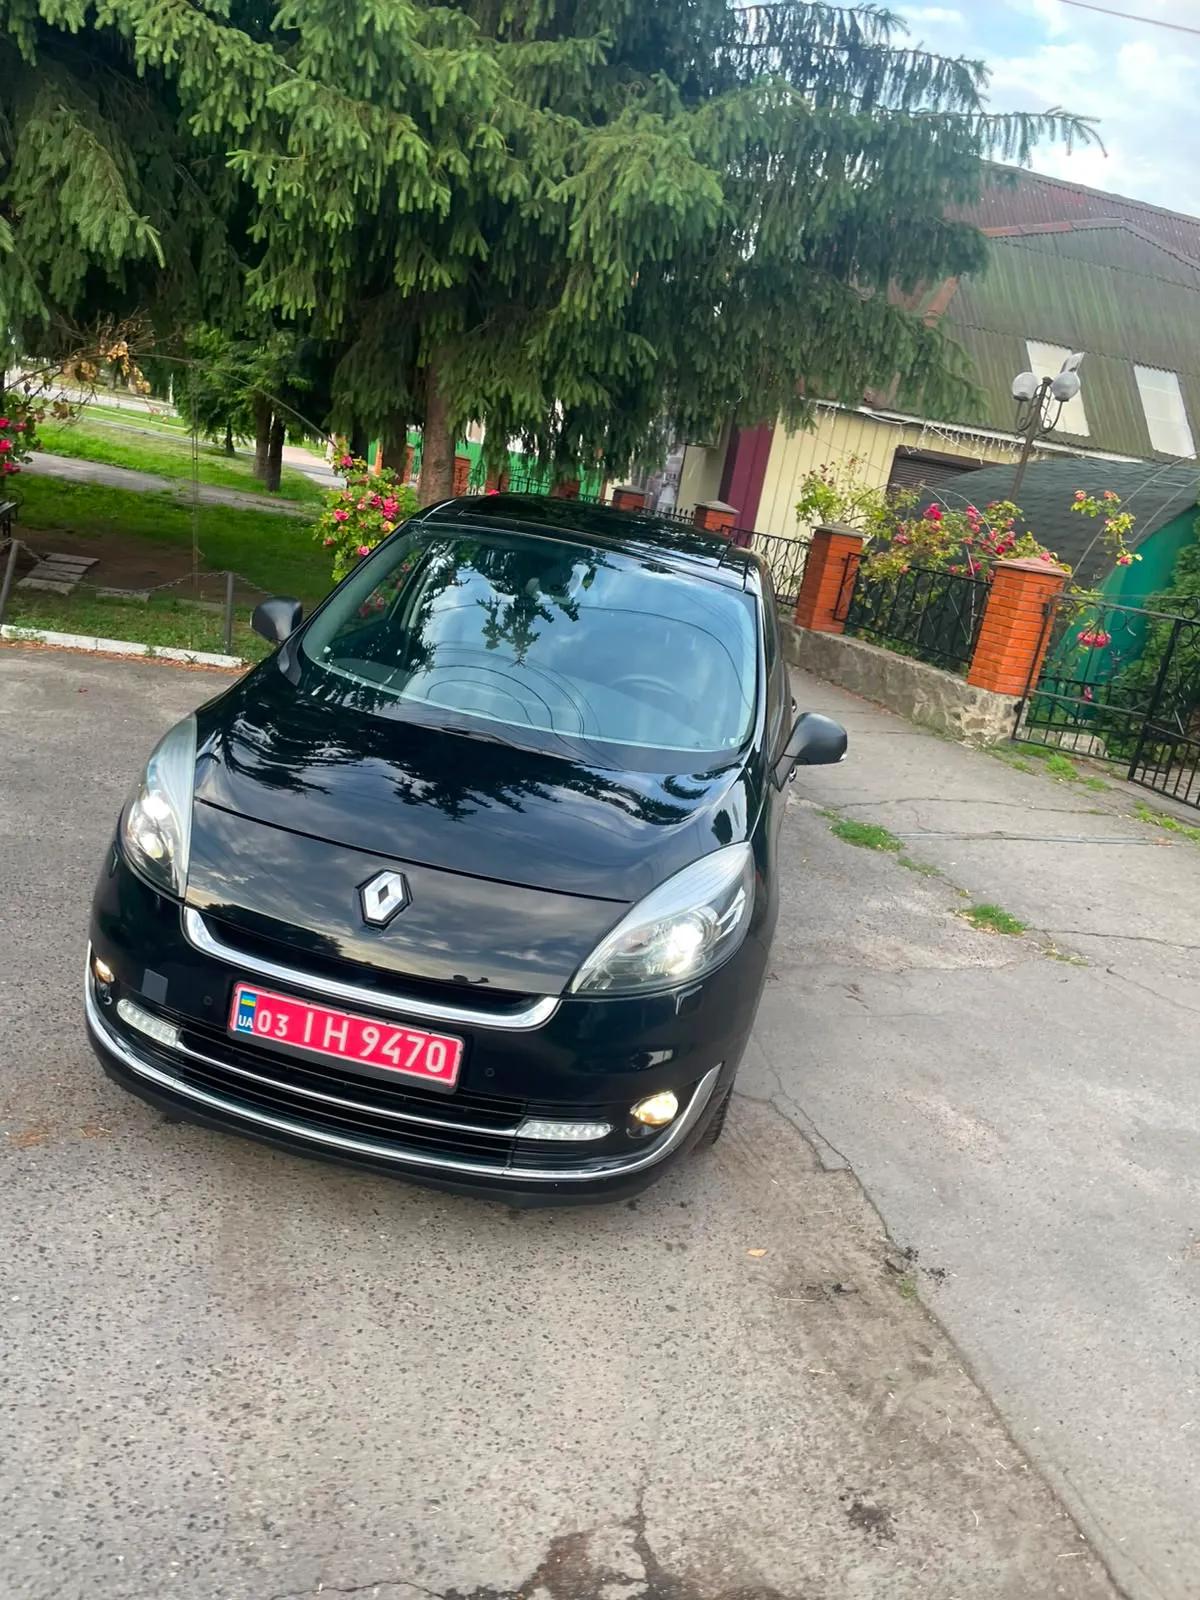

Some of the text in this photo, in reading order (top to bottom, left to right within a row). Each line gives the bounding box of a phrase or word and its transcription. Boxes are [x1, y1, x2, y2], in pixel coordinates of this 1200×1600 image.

[238, 1015, 253, 1028] UA
[257, 1010, 288, 1037] 03
[360, 1026, 446, 1073] 9470
